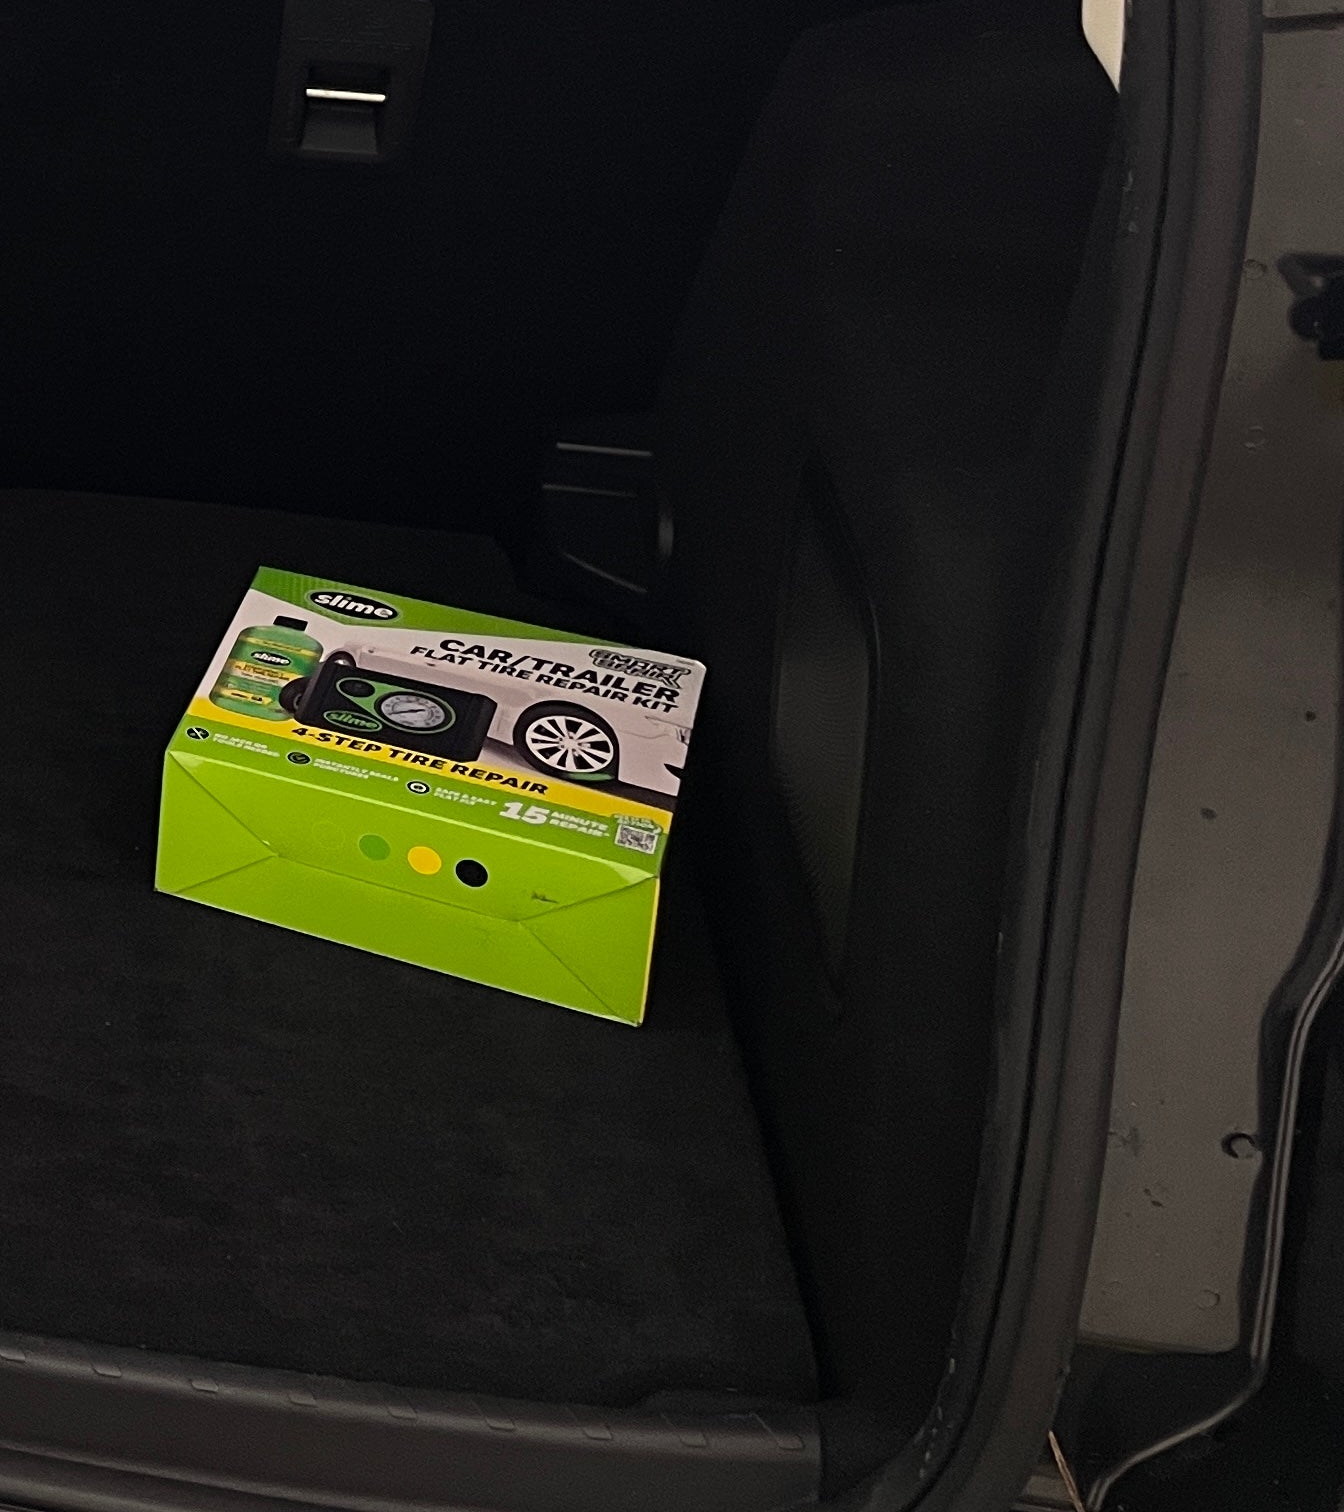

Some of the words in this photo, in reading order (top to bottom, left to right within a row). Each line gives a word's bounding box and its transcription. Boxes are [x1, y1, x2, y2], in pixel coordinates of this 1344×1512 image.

[314, 592, 394, 619] slime
[438, 638, 681, 704] CAR/TRAILER
[589, 648, 692, 675] SMART
[409, 645, 471, 667] FLAT
[478, 660, 531, 681] TIRE
[534, 672, 629, 704] REPAIR
[631, 695, 679, 714] KIT
[329, 711, 379, 729] slime
[291, 727, 383, 754] 4-STEP
[388, 747, 445, 772] TIRE
[450, 762, 550, 796] REPAIR
[499, 801, 550, 826] 15
[549, 810, 610, 831] MINUTE
